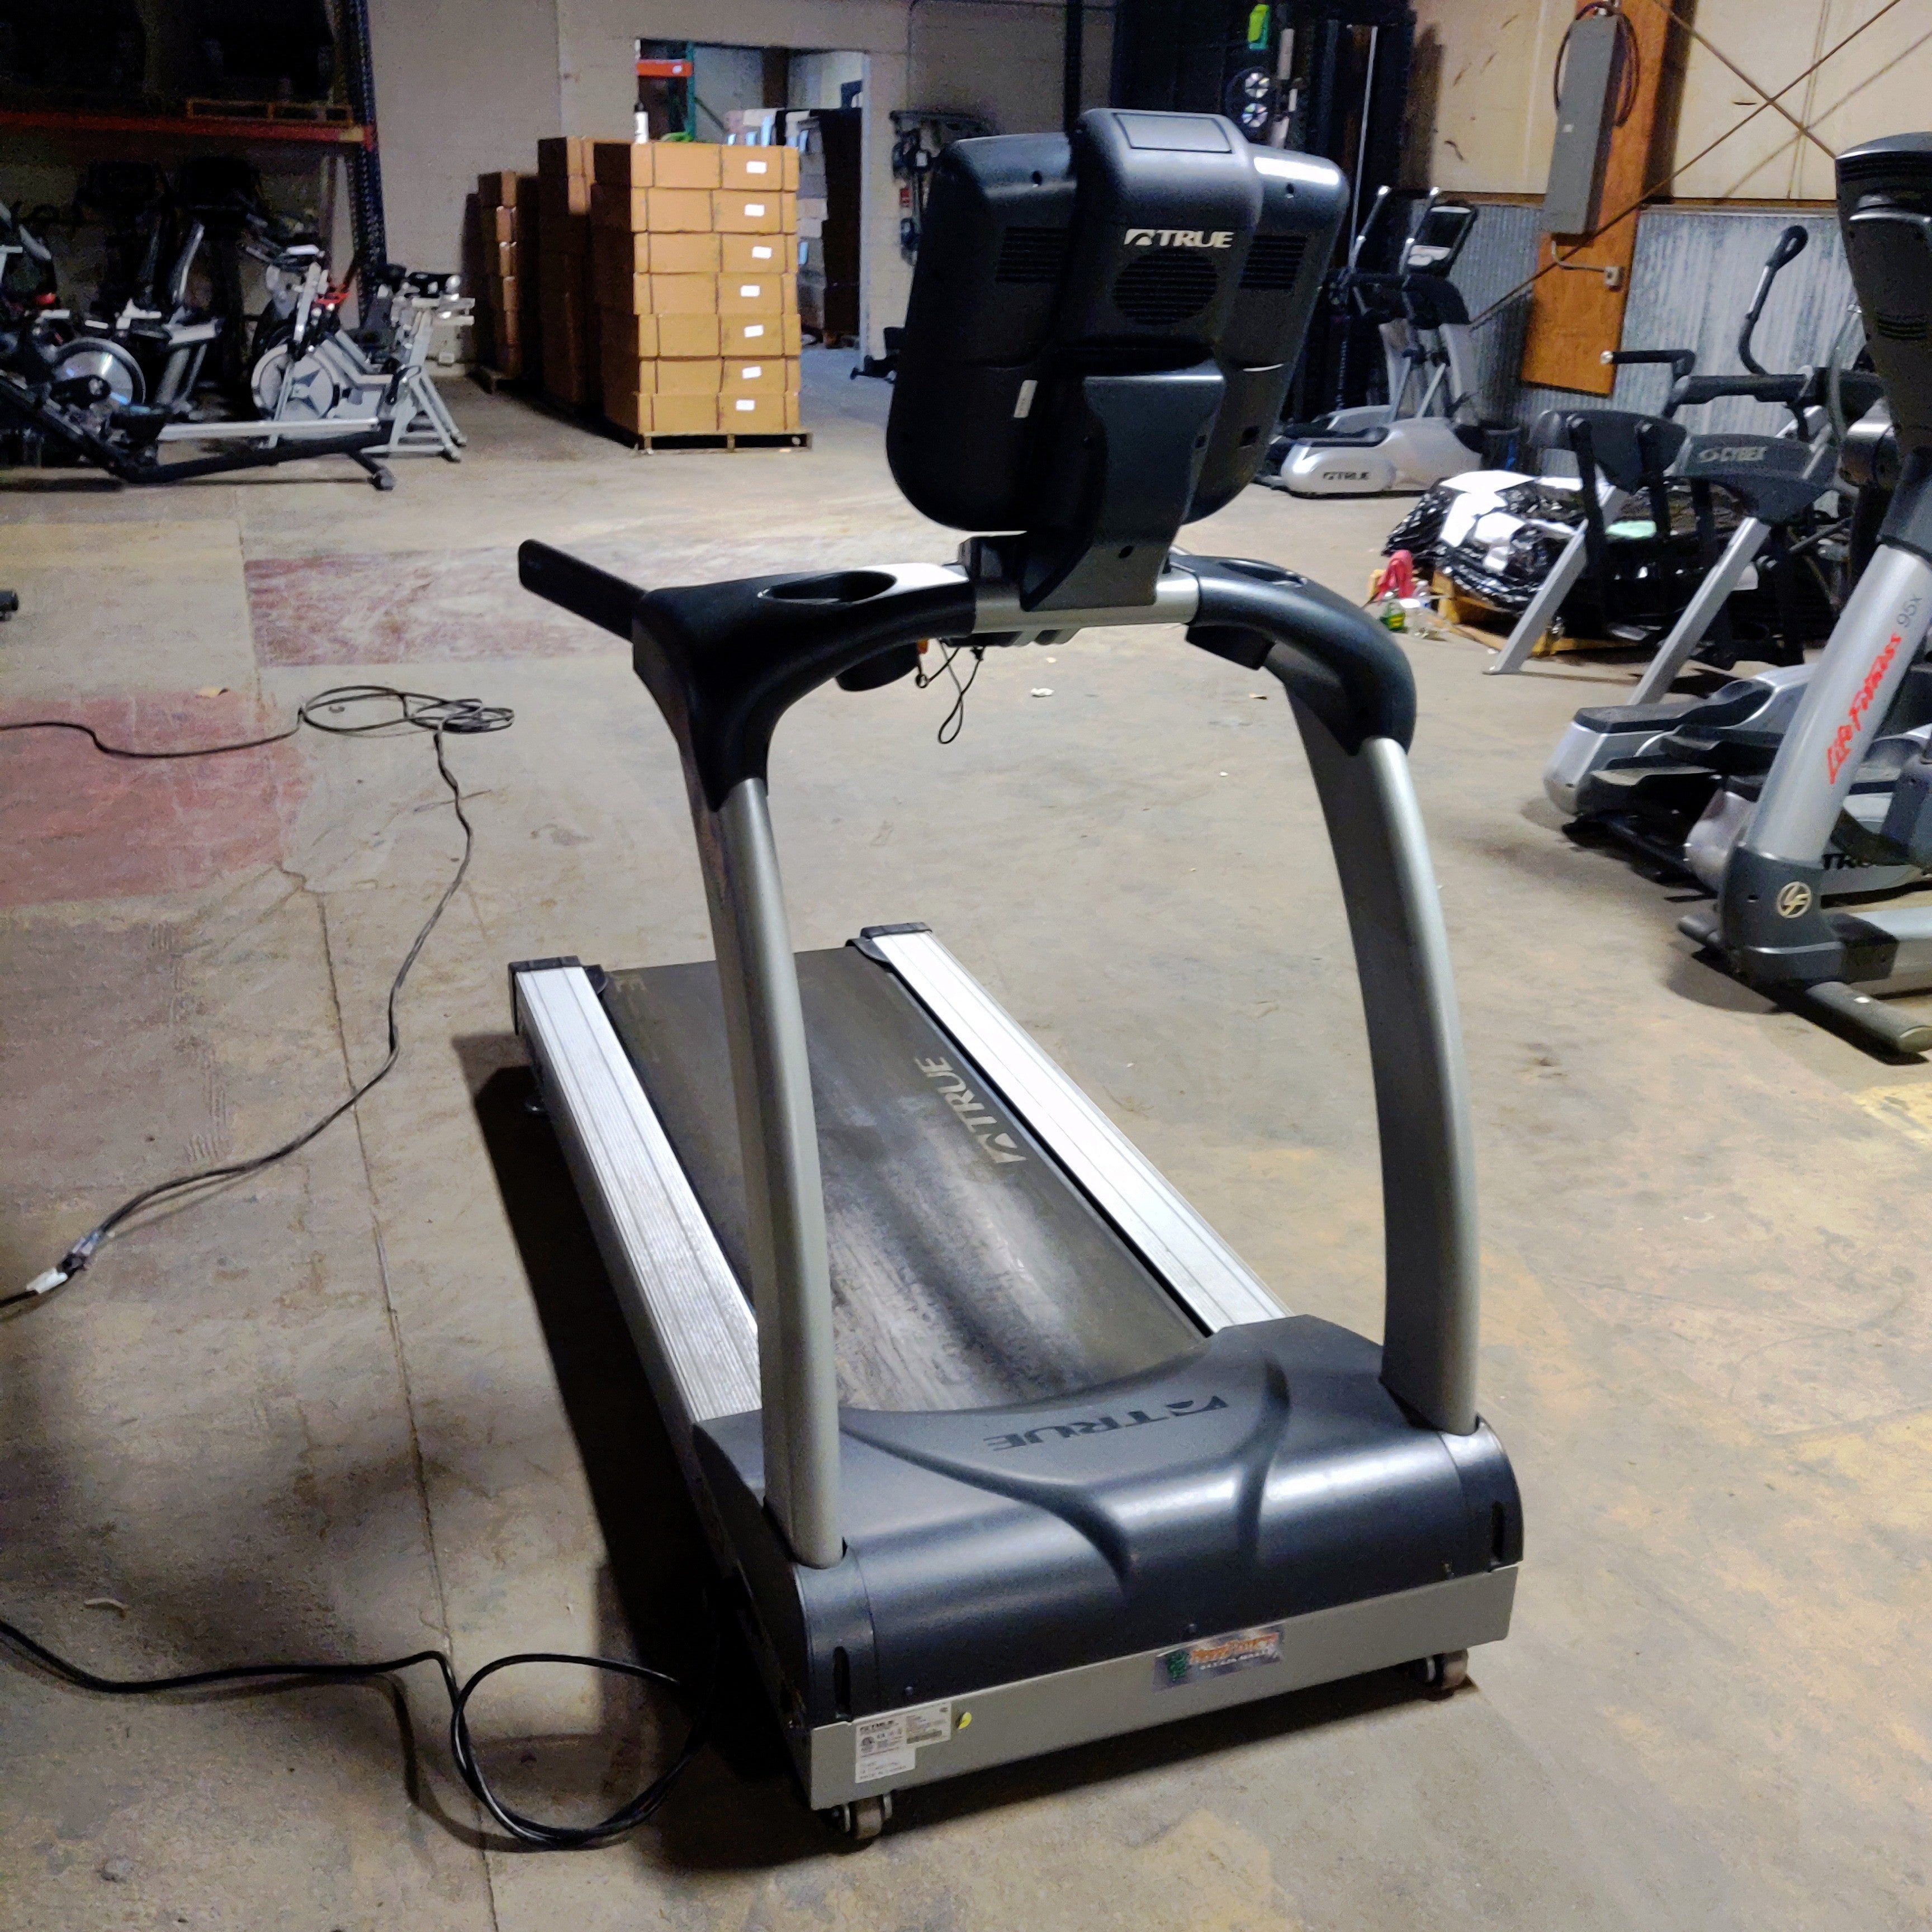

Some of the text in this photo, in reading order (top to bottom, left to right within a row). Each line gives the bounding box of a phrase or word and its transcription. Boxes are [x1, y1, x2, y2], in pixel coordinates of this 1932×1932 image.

[1156, 230, 1234, 248] TRUE
[914, 1056, 998, 1133] TRUE
[983, 1410, 1169, 1452] TRUE
